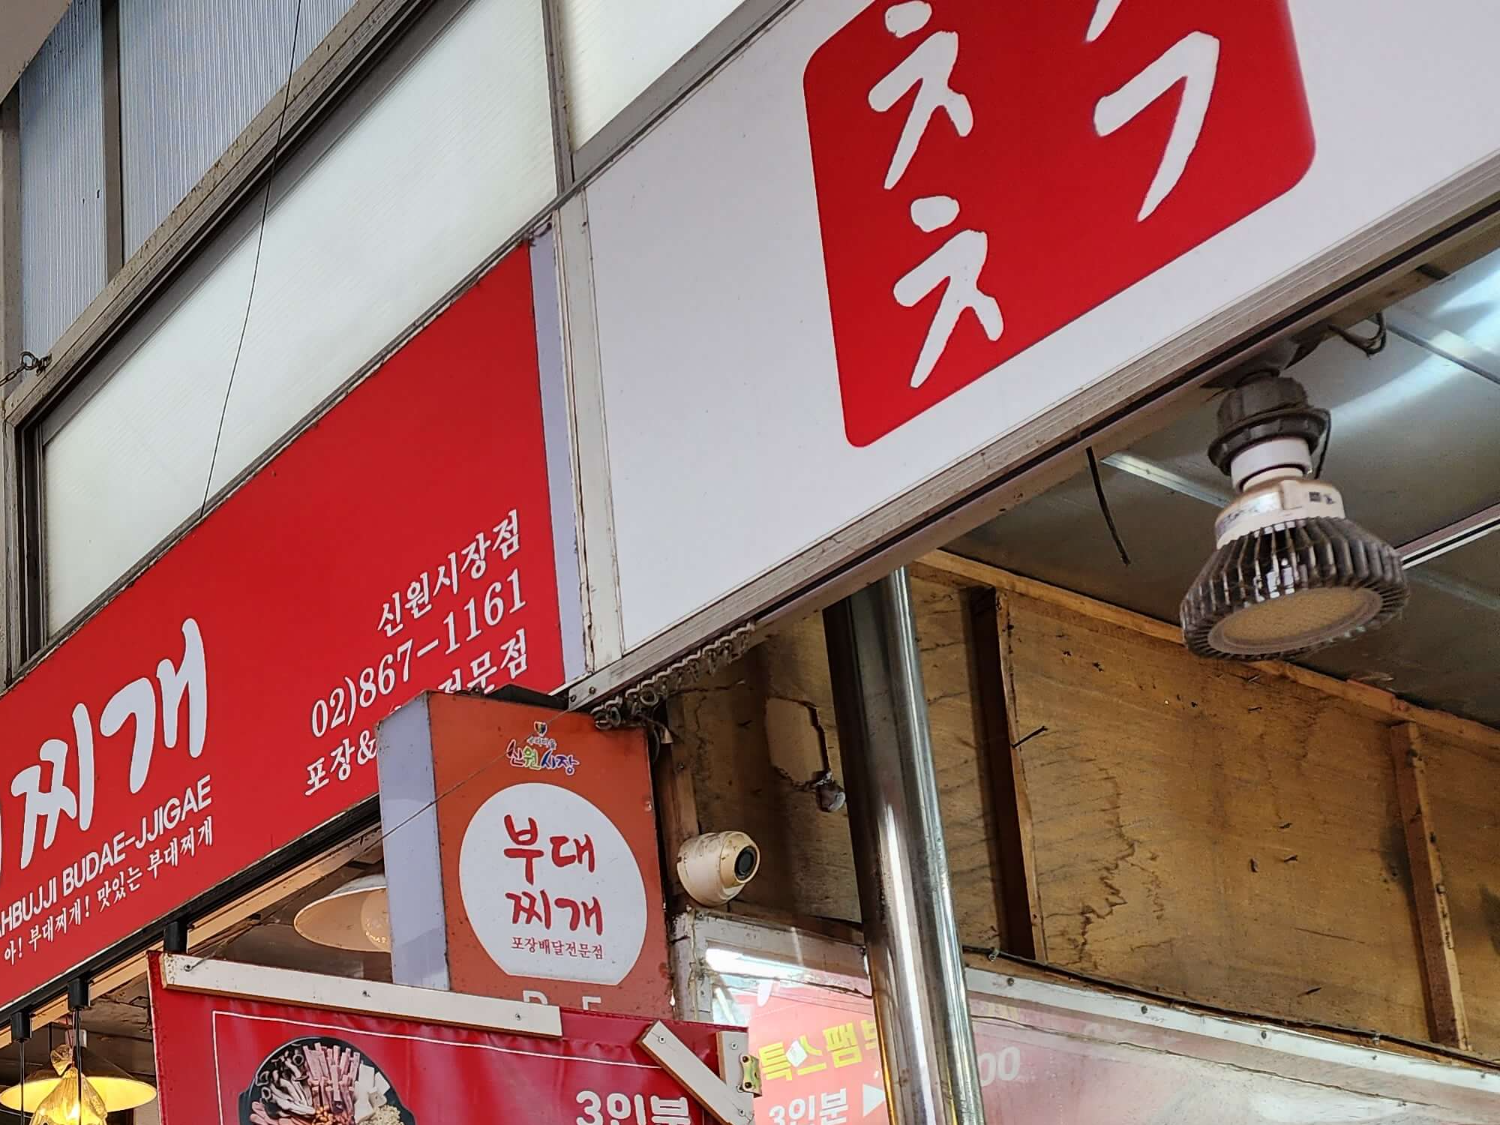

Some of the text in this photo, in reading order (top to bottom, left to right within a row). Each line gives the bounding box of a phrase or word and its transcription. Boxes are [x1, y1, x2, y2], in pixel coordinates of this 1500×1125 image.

[377, 509, 521, 638] 신원시장점
[310, 568, 527, 738] 02)867-1161
[506, 738, 581, 777] 신원시장
[62, 775, 213, 896] BUDAE-JJIGAE
[503, 814, 597, 886] 부대
[3, 818, 214, 966] 아! 부대찌개! 맛있는 부대찌개
[503, 888, 605, 937] 찌개
[510, 936, 605, 961] 포장배달전문점
